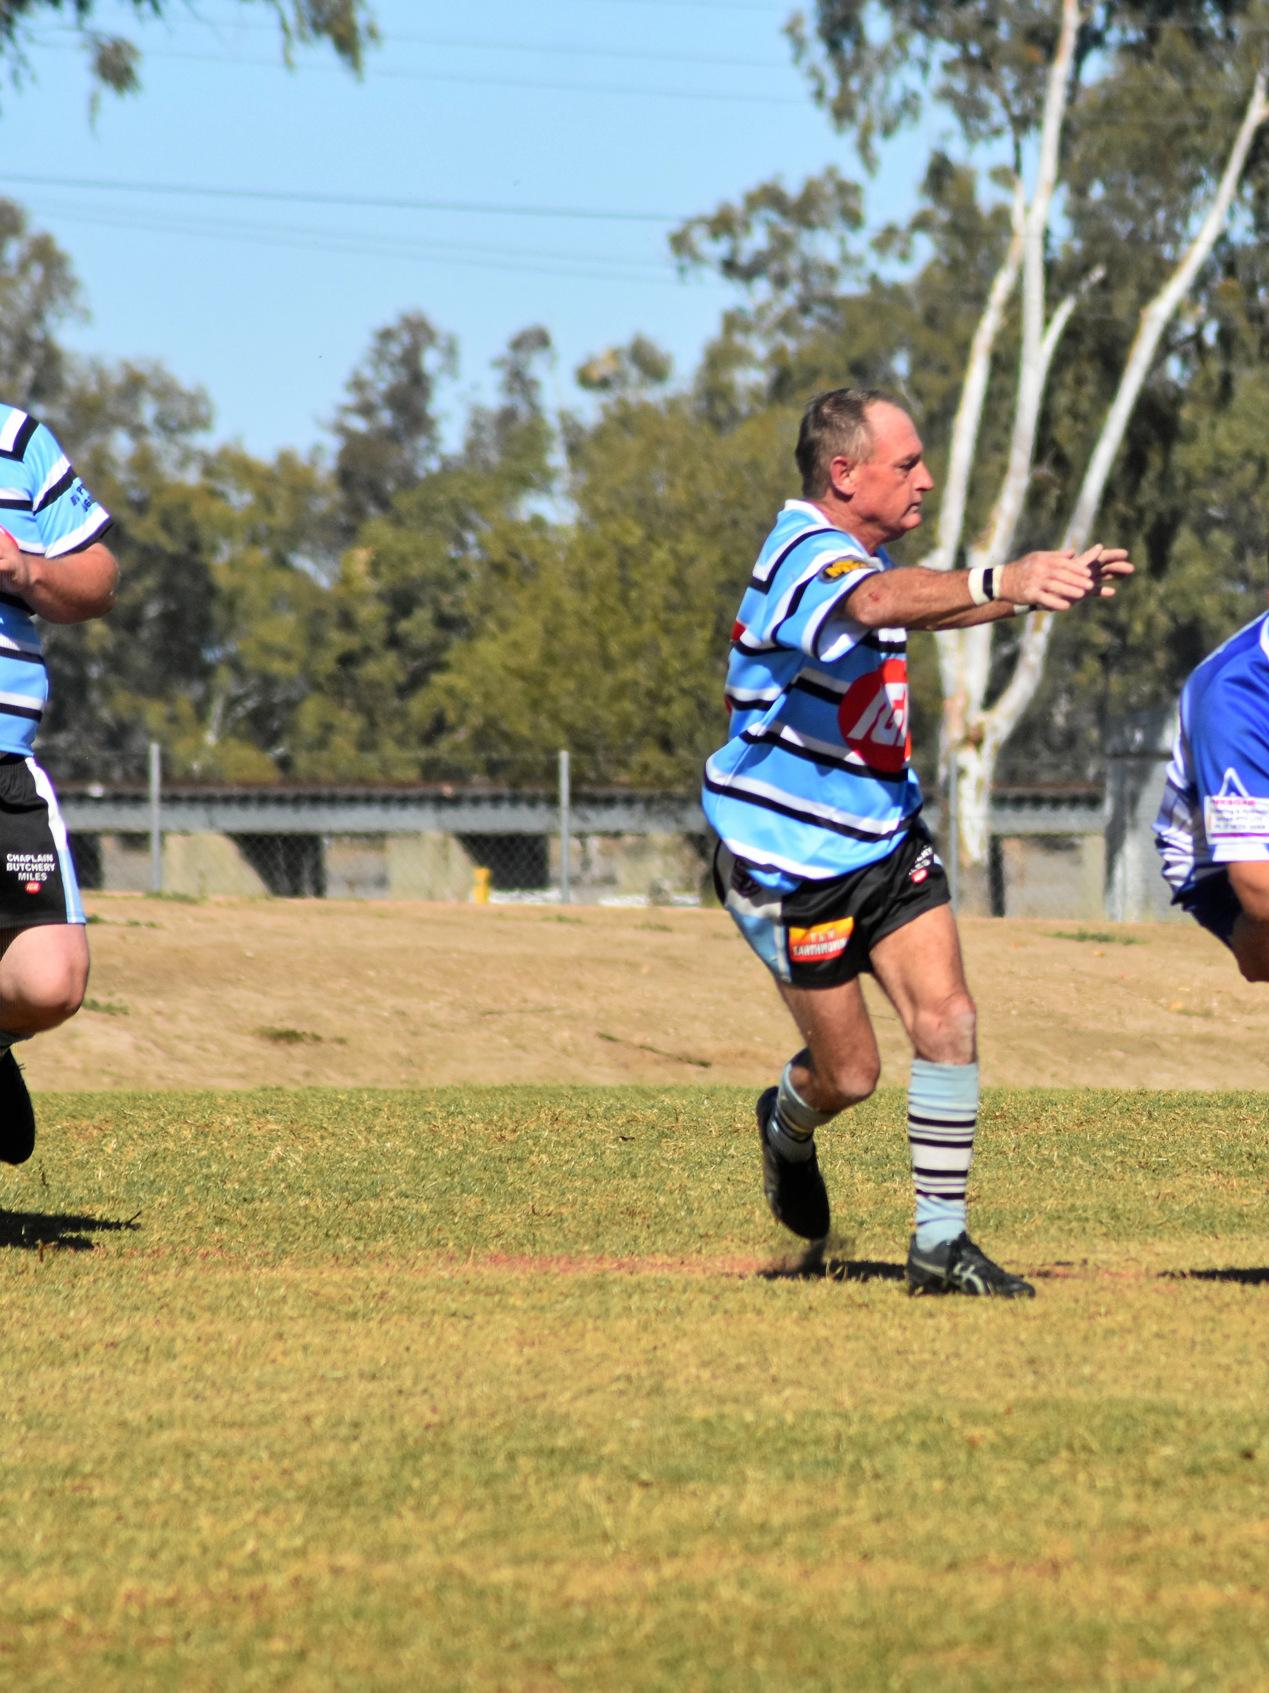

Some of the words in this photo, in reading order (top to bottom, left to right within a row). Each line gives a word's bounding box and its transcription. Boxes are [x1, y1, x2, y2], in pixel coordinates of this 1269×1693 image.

[6, 853, 54, 862] CHAPLAIN
[6, 862, 56, 871] BUTCHERY
[18, 872, 48, 881] MILES
